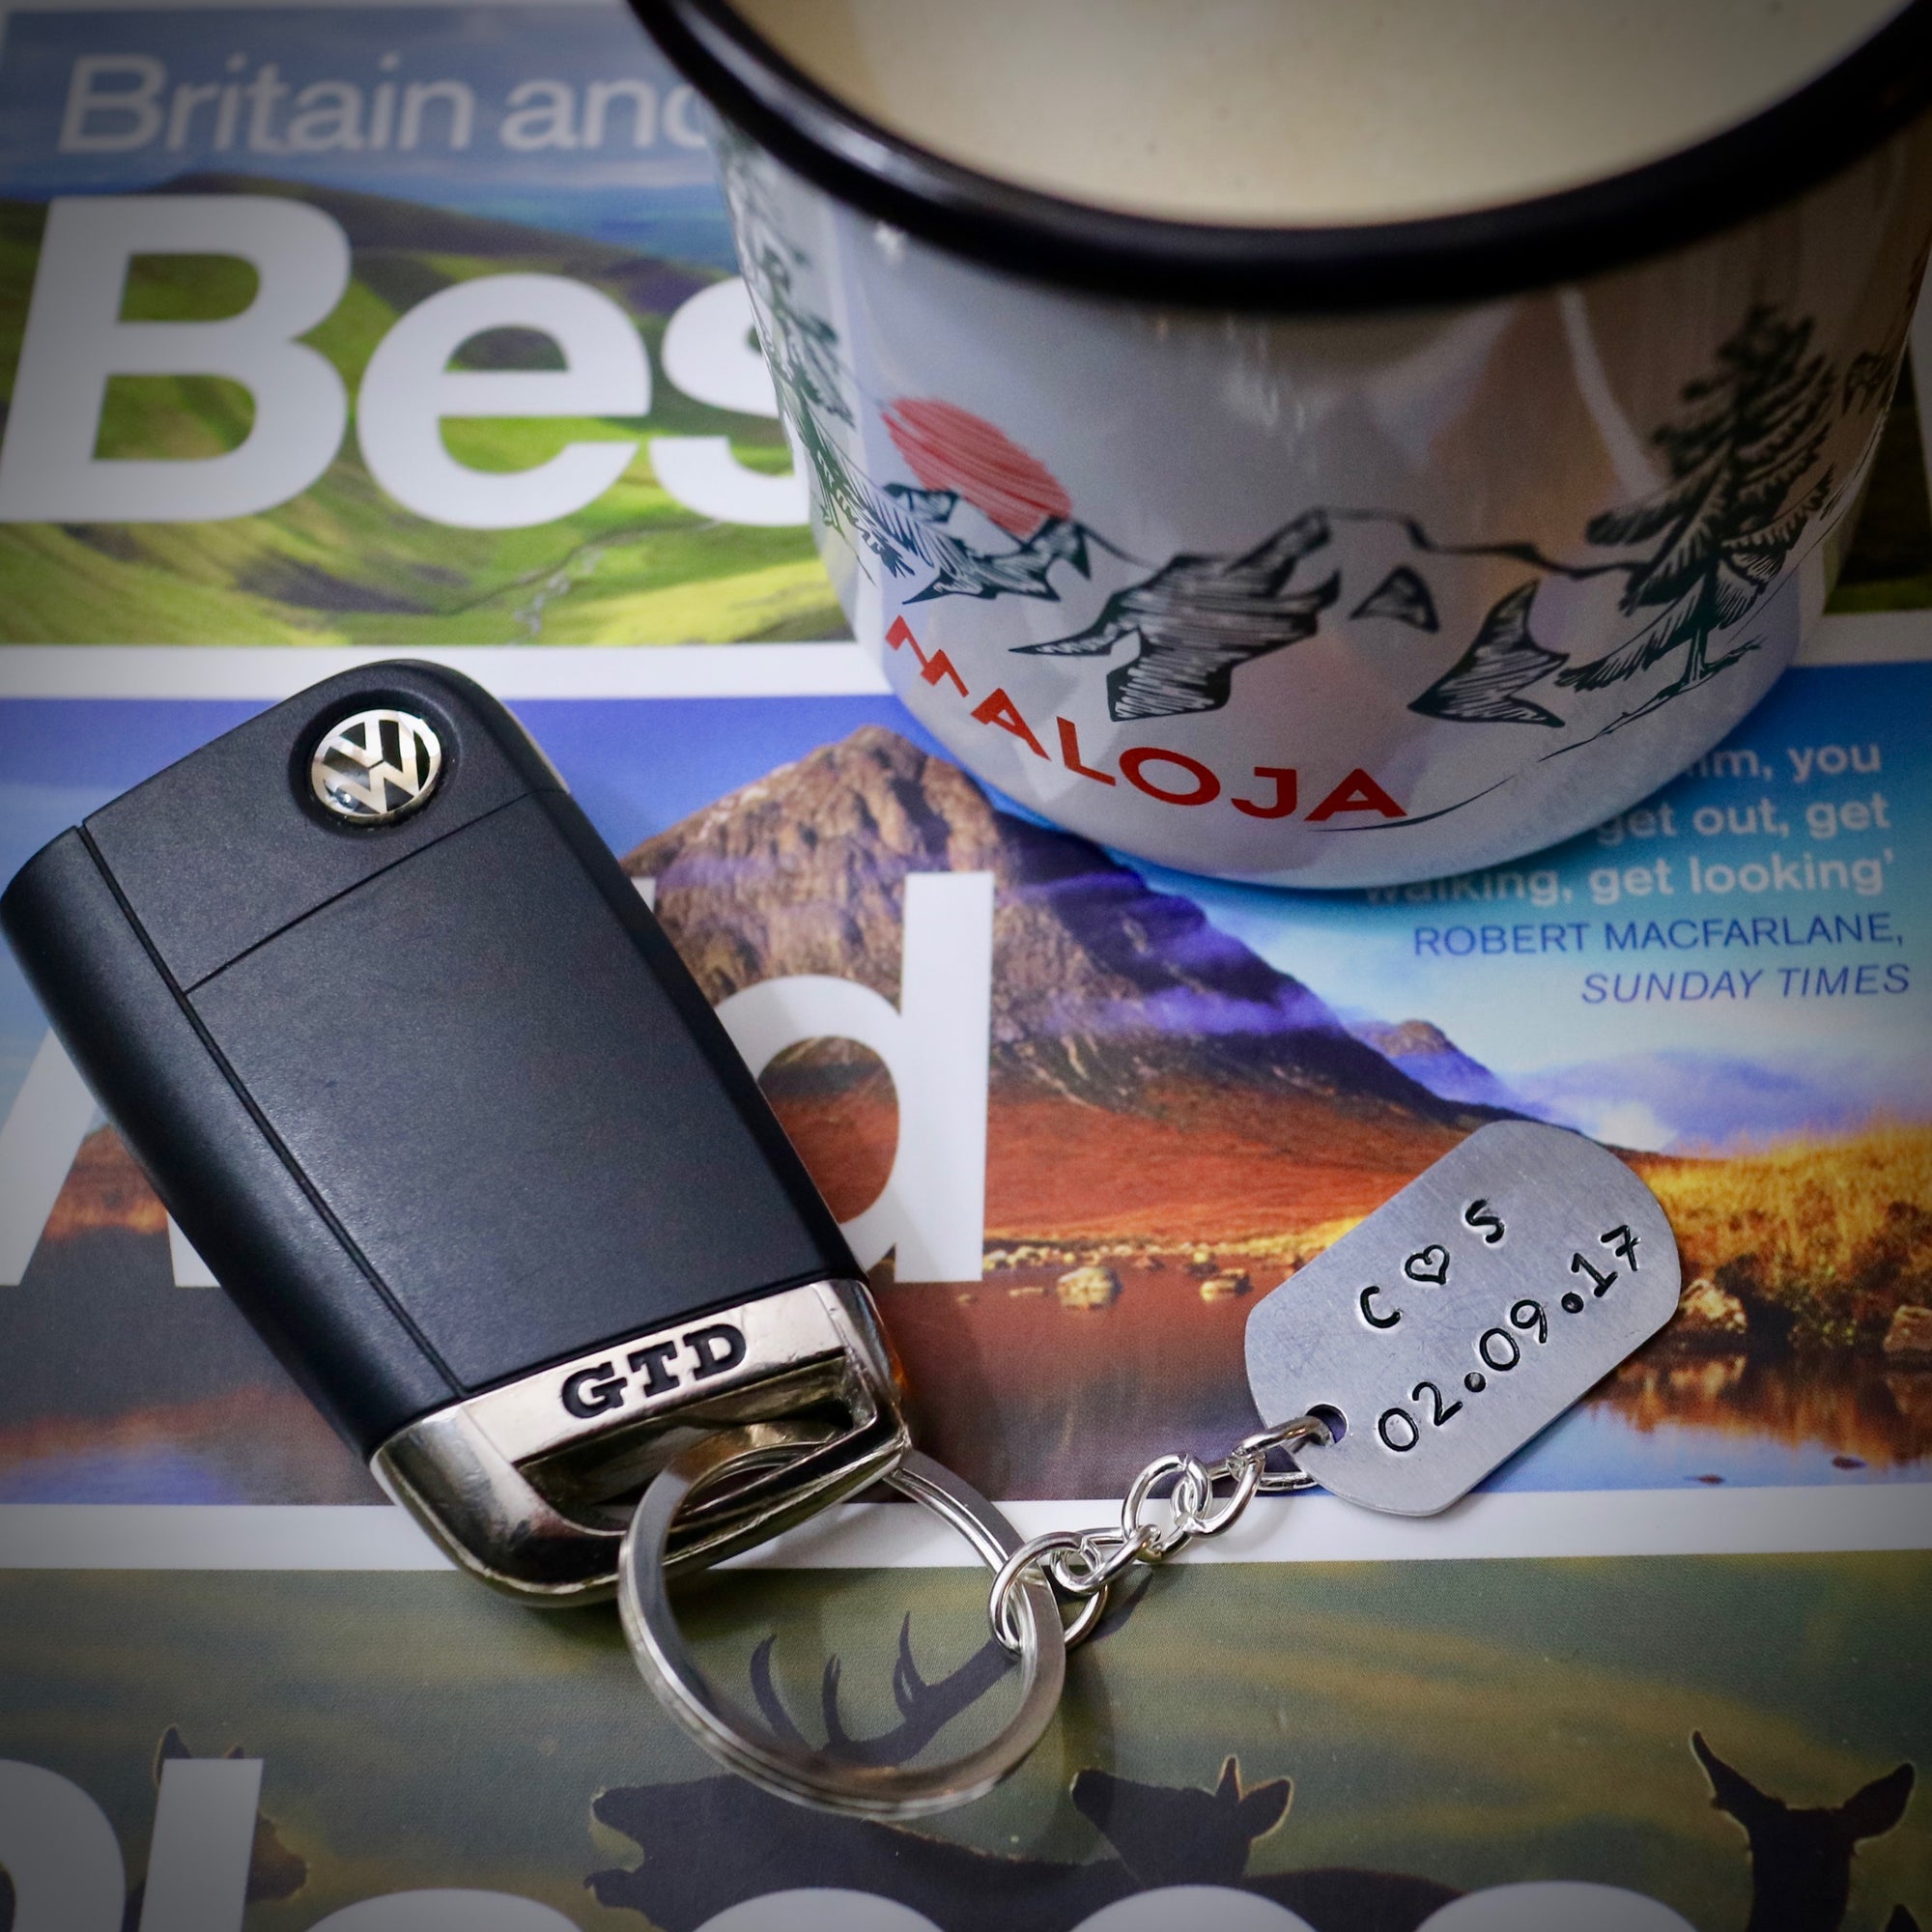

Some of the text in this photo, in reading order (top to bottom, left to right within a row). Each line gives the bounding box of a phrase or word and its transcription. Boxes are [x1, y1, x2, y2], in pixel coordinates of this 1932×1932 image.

[56, 53, 475, 155] Britain
[885, 614, 1407, 822] MALOJA
[1787, 743, 1882, 781] you
[1596, 791, 1892, 846] get out, get
[1589, 863, 1674, 906] get
[1413, 912, 1904, 957] ROBERT MACFARLANE,
[1581, 963, 1912, 1005] SUNDAY TIMES
[1357, 1198, 1506, 1330] C S
[560, 1322, 748, 1419] GTD
[1378, 1224, 1640, 1452] 02.09.17
